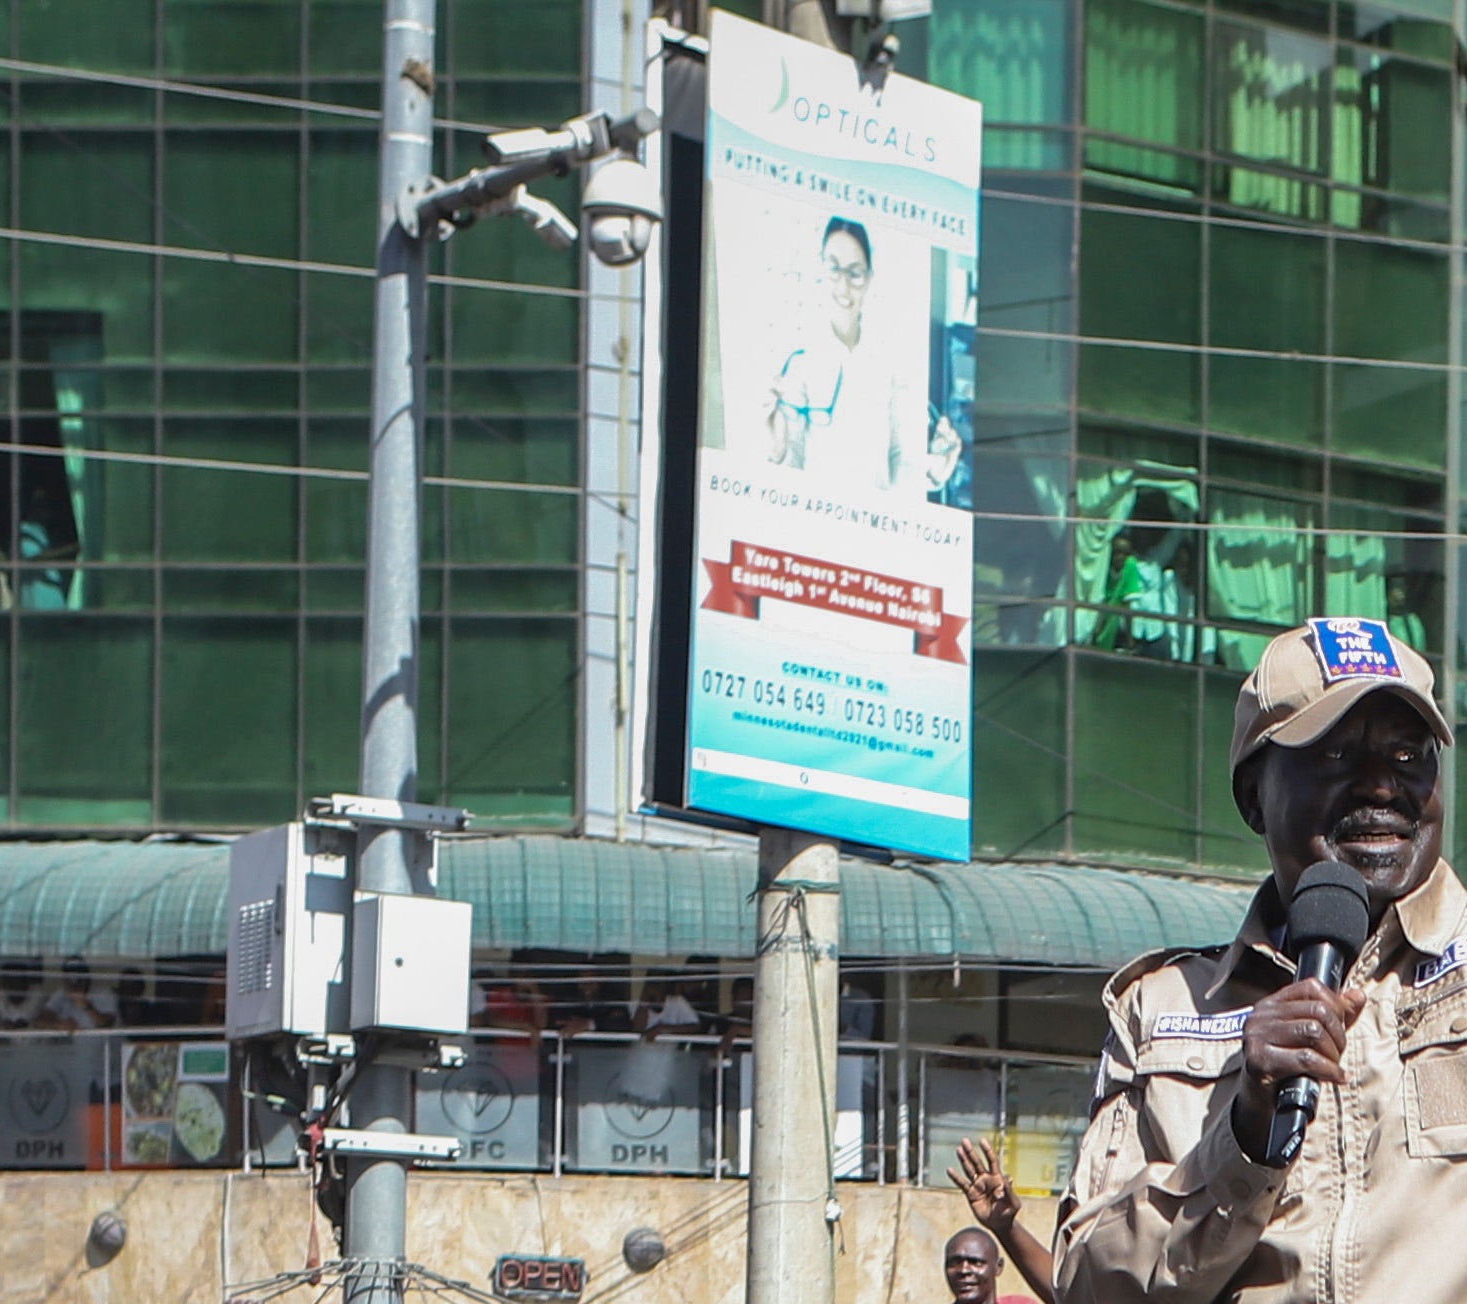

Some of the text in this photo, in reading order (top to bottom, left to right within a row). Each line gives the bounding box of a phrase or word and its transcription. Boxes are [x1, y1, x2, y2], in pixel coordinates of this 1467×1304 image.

[793, 97, 936, 162] OPTICALS
[725, 148, 966, 236] PUTTING A SMILE ON EVERY FACE
[710, 474, 961, 546] BOOK YOUR APPOINTMENT TODAY
[732, 566, 804, 599] Eastleigh
[829, 588, 885, 615] Avenue
[887, 601, 943, 628] Nairobi
[783, 555, 836, 584] Towers
[863, 574, 909, 602] Floor,
[1336, 636, 1372, 650] THE
[1338, 650, 1388, 665] FIFTH
[782, 661, 840, 685] CONTACT
[845, 673, 862, 688] US
[702, 669, 962, 744] 0727 054 649 0723 058 500
[612, 1144, 669, 1164] DPH
[500, 1258, 580, 1291] OPEN
